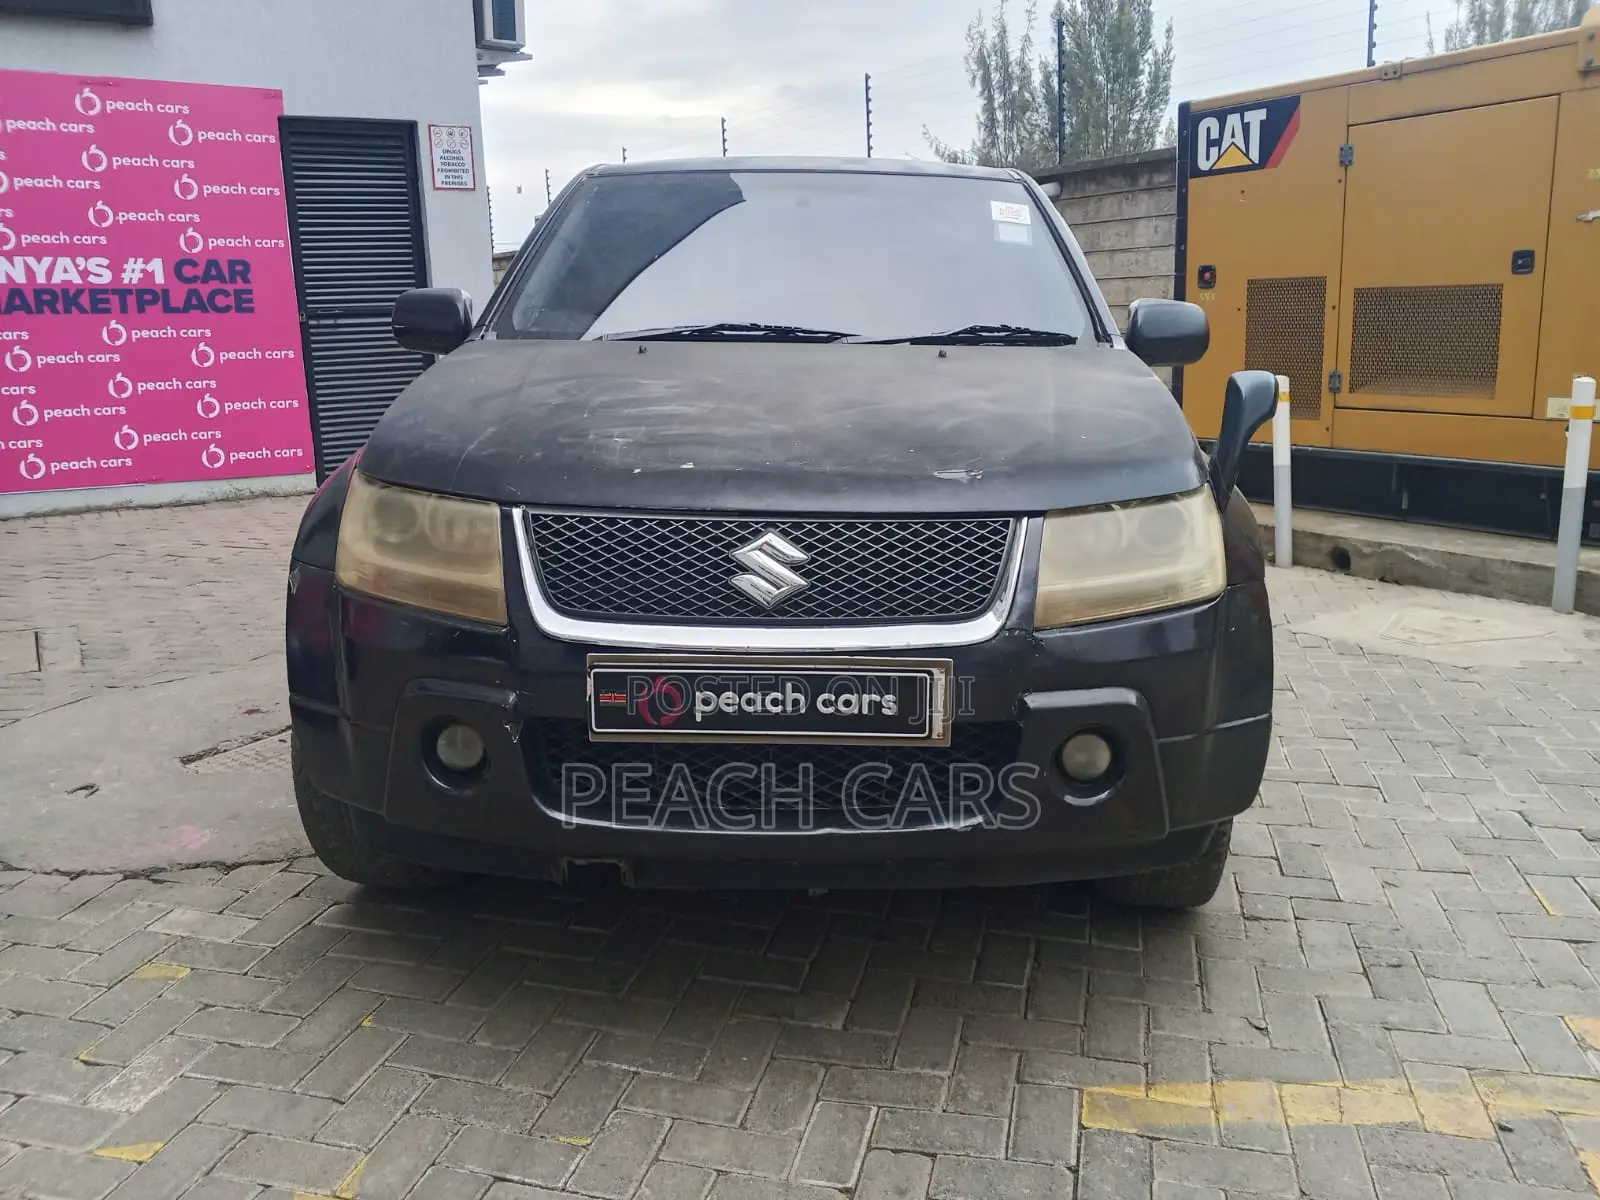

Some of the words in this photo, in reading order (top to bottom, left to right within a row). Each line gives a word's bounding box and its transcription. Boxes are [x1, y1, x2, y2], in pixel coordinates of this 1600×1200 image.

[106, 98, 153, 113] peach
[156, 104, 190, 114] cars
[6, 117, 57, 132] peach
[60, 123, 95, 133] cars
[197, 128, 243, 143] peach
[245, 133, 277, 143] cars
[1197, 108, 1267, 170] CAT
[112, 154, 159, 169] peach
[163, 159, 195, 168] cars
[13, 174, 63, 190] peach
[66, 179, 101, 189] cars
[203, 182, 247, 197] peach
[250, 187, 281, 196] cars
[118, 208, 165, 223] peach
[168, 213, 200, 222] cars
[20, 231, 70, 247] peach
[73, 235, 107, 244] cars
[207, 234, 253, 249] peach
[255, 239, 285, 248] cars
[121, 257, 165, 285] #1
[174, 258, 252, 284] CAR
[0, 287, 255, 315] ARKETPLACE
[131, 325, 177, 342] peach
[179, 328, 212, 338] cars
[36, 351, 85, 368] peach
[88, 354, 121, 363] cars
[219, 349, 263, 361] peach
[266, 349, 295, 359] cars
[1, 385, 37, 395] cars
[137, 377, 183, 393] peach
[185, 379, 217, 390] cars
[43, 404, 91, 421] peach
[94, 406, 127, 416] cars
[224, 399, 267, 413] peach
[270, 398, 299, 409] cars
[8, 439, 44, 449] cars
[143, 428, 188, 445] peach
[190, 429, 222, 440] cars
[228, 450, 272, 464] peach
[274, 447, 303, 458] cars
[50, 457, 97, 474] peach
[100, 458, 133, 468] cars
[695, 683, 806, 722] peach
[816, 692, 898, 716] cars
